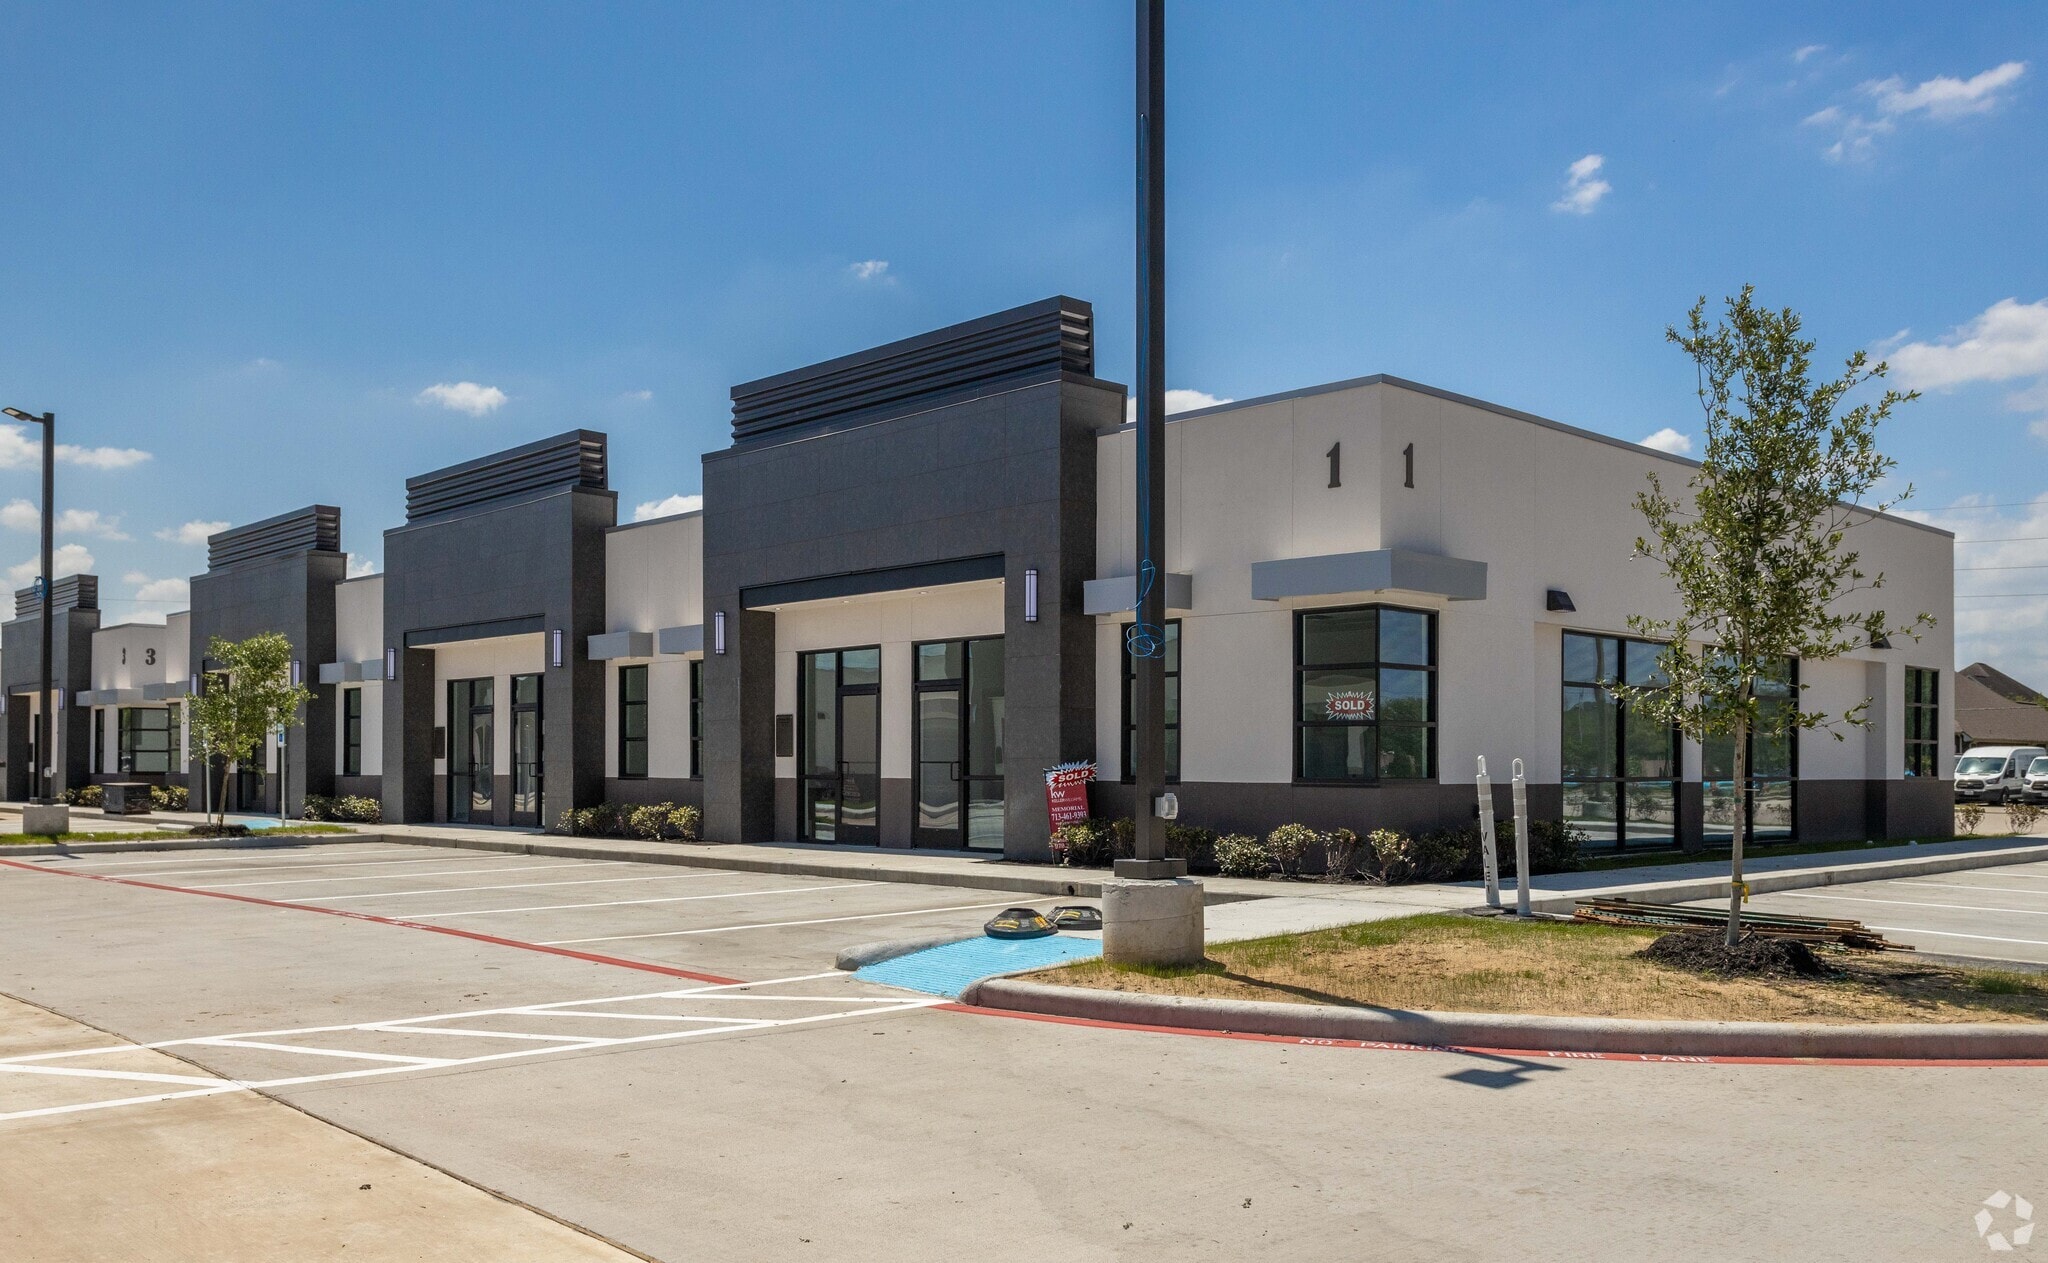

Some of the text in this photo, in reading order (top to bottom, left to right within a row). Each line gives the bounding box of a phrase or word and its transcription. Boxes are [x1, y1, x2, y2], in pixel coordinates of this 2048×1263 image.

[1326, 441, 1342, 489] 1
[1403, 442, 1415, 489] 1
[145, 647, 156, 666] 3
[1334, 700, 1366, 711] SOLD
[1058, 771, 1089, 782] SOLD
[1481, 831, 1491, 894] VALET
[1547, 1051, 1605, 1059] FIRE
[1639, 1055, 1715, 1063] LANE
